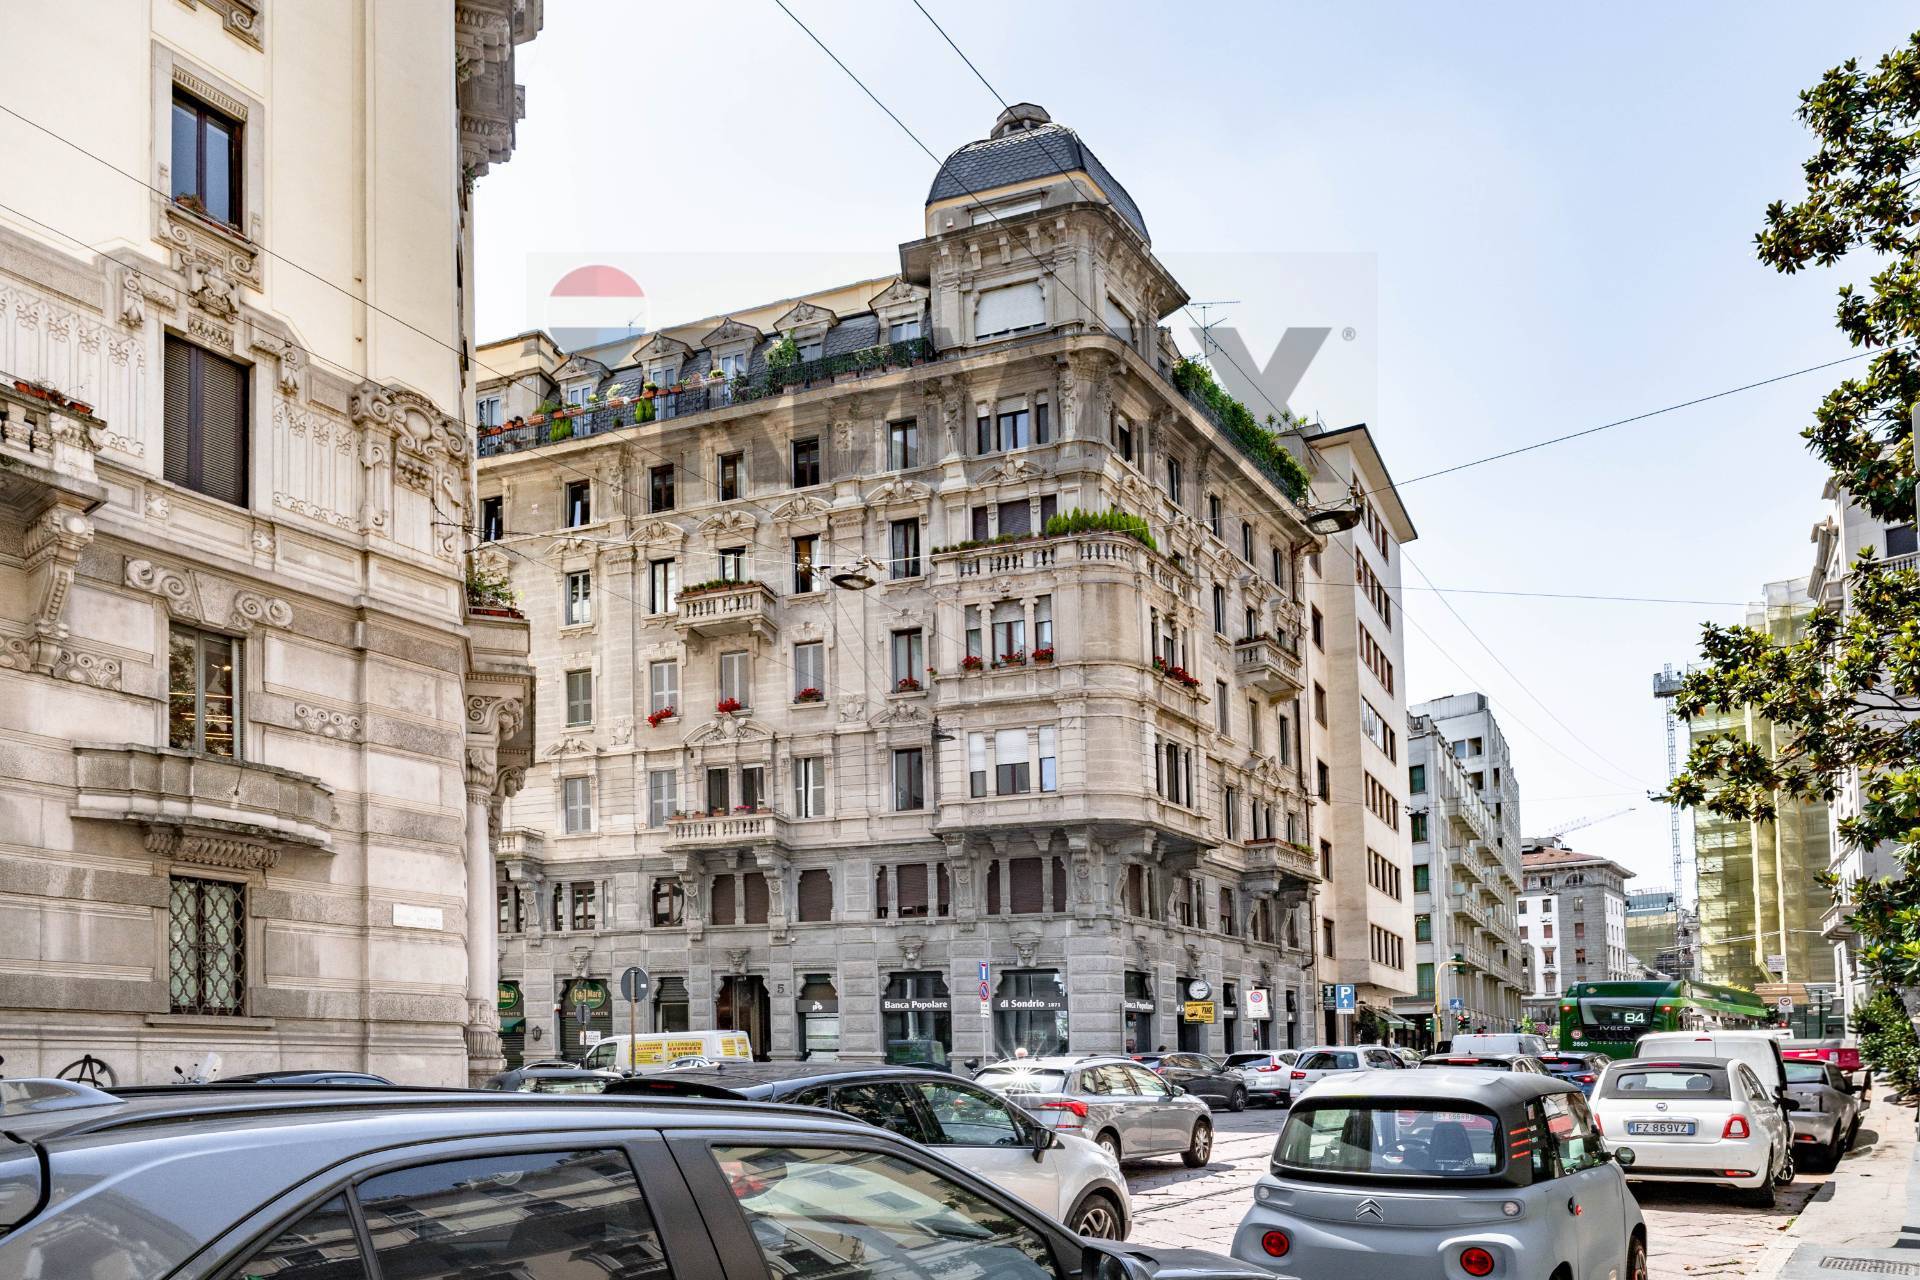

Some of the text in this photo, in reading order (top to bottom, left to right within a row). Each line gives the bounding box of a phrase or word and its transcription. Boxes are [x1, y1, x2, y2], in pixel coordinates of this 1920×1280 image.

[777, 984, 785, 993] 5
[1341, 987, 1351, 998] P
[884, 1000, 948, 1010] Banca Popolare
[1000, 999, 1009, 1008] di
[1011, 999, 1045, 1008] Sondrio
[1624, 1012, 1645, 1023] 84
[1636, 1123, 1687, 1133] FZ 869VZ
